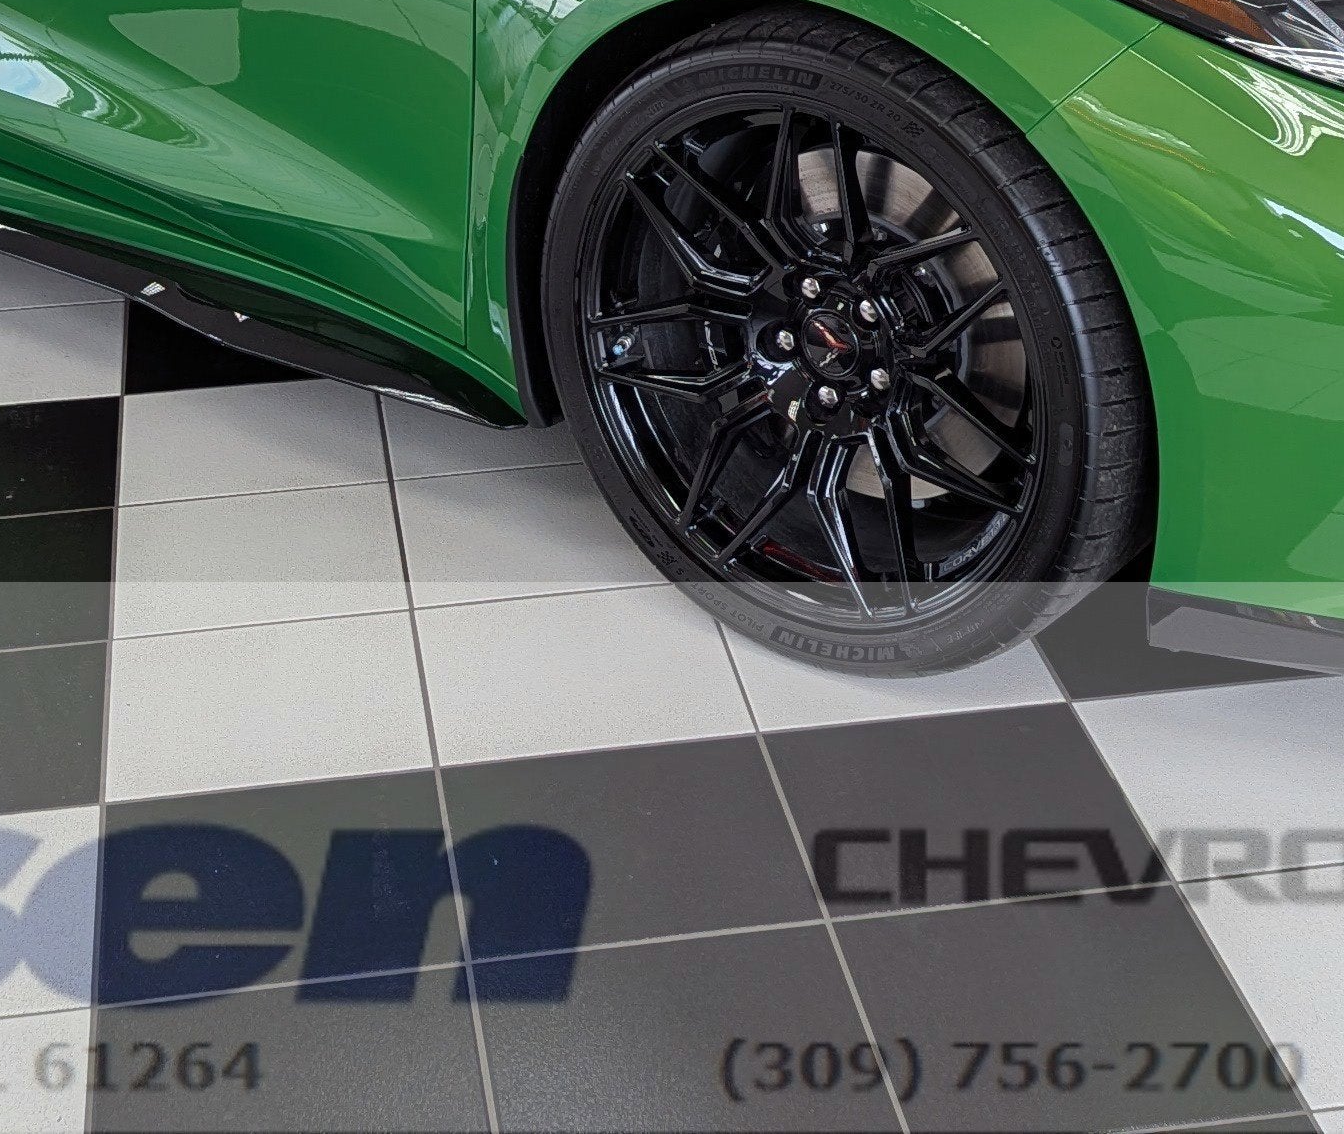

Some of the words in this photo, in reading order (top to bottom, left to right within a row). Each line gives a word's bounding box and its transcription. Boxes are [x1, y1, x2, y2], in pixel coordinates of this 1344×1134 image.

[698, 66, 815, 87] MICHELIN
[870, 99, 886, 113] ZR
[887, 110, 901, 123] 20
[691, 580, 728, 612] SPORT
[729, 610, 765, 632] PILOT
[776, 629, 898, 662] MICHELIN
